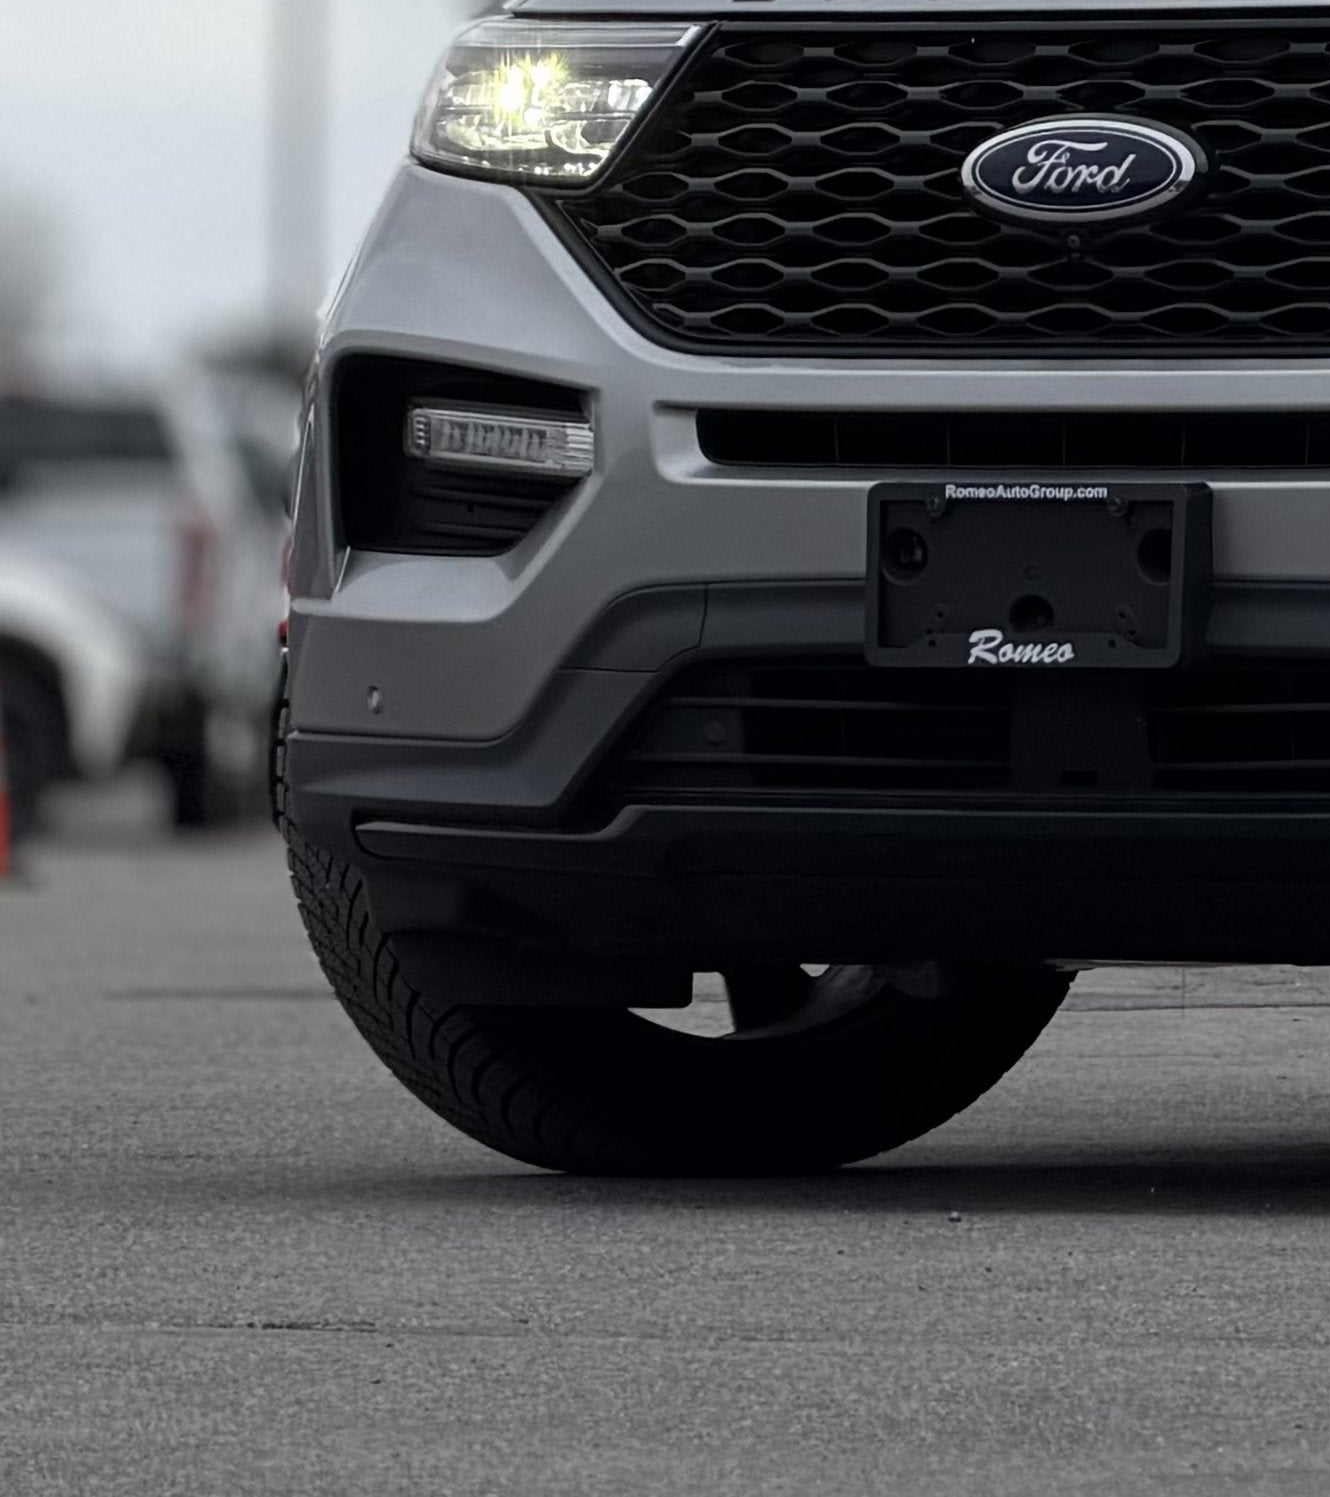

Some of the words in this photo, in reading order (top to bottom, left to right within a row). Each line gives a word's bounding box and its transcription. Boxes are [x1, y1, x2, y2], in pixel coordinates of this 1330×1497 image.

[1011, 139, 1136, 194] Ford
[945, 483, 1108, 501] RomeoAutoGroup.com
[967, 628, 1076, 665] Romeo
